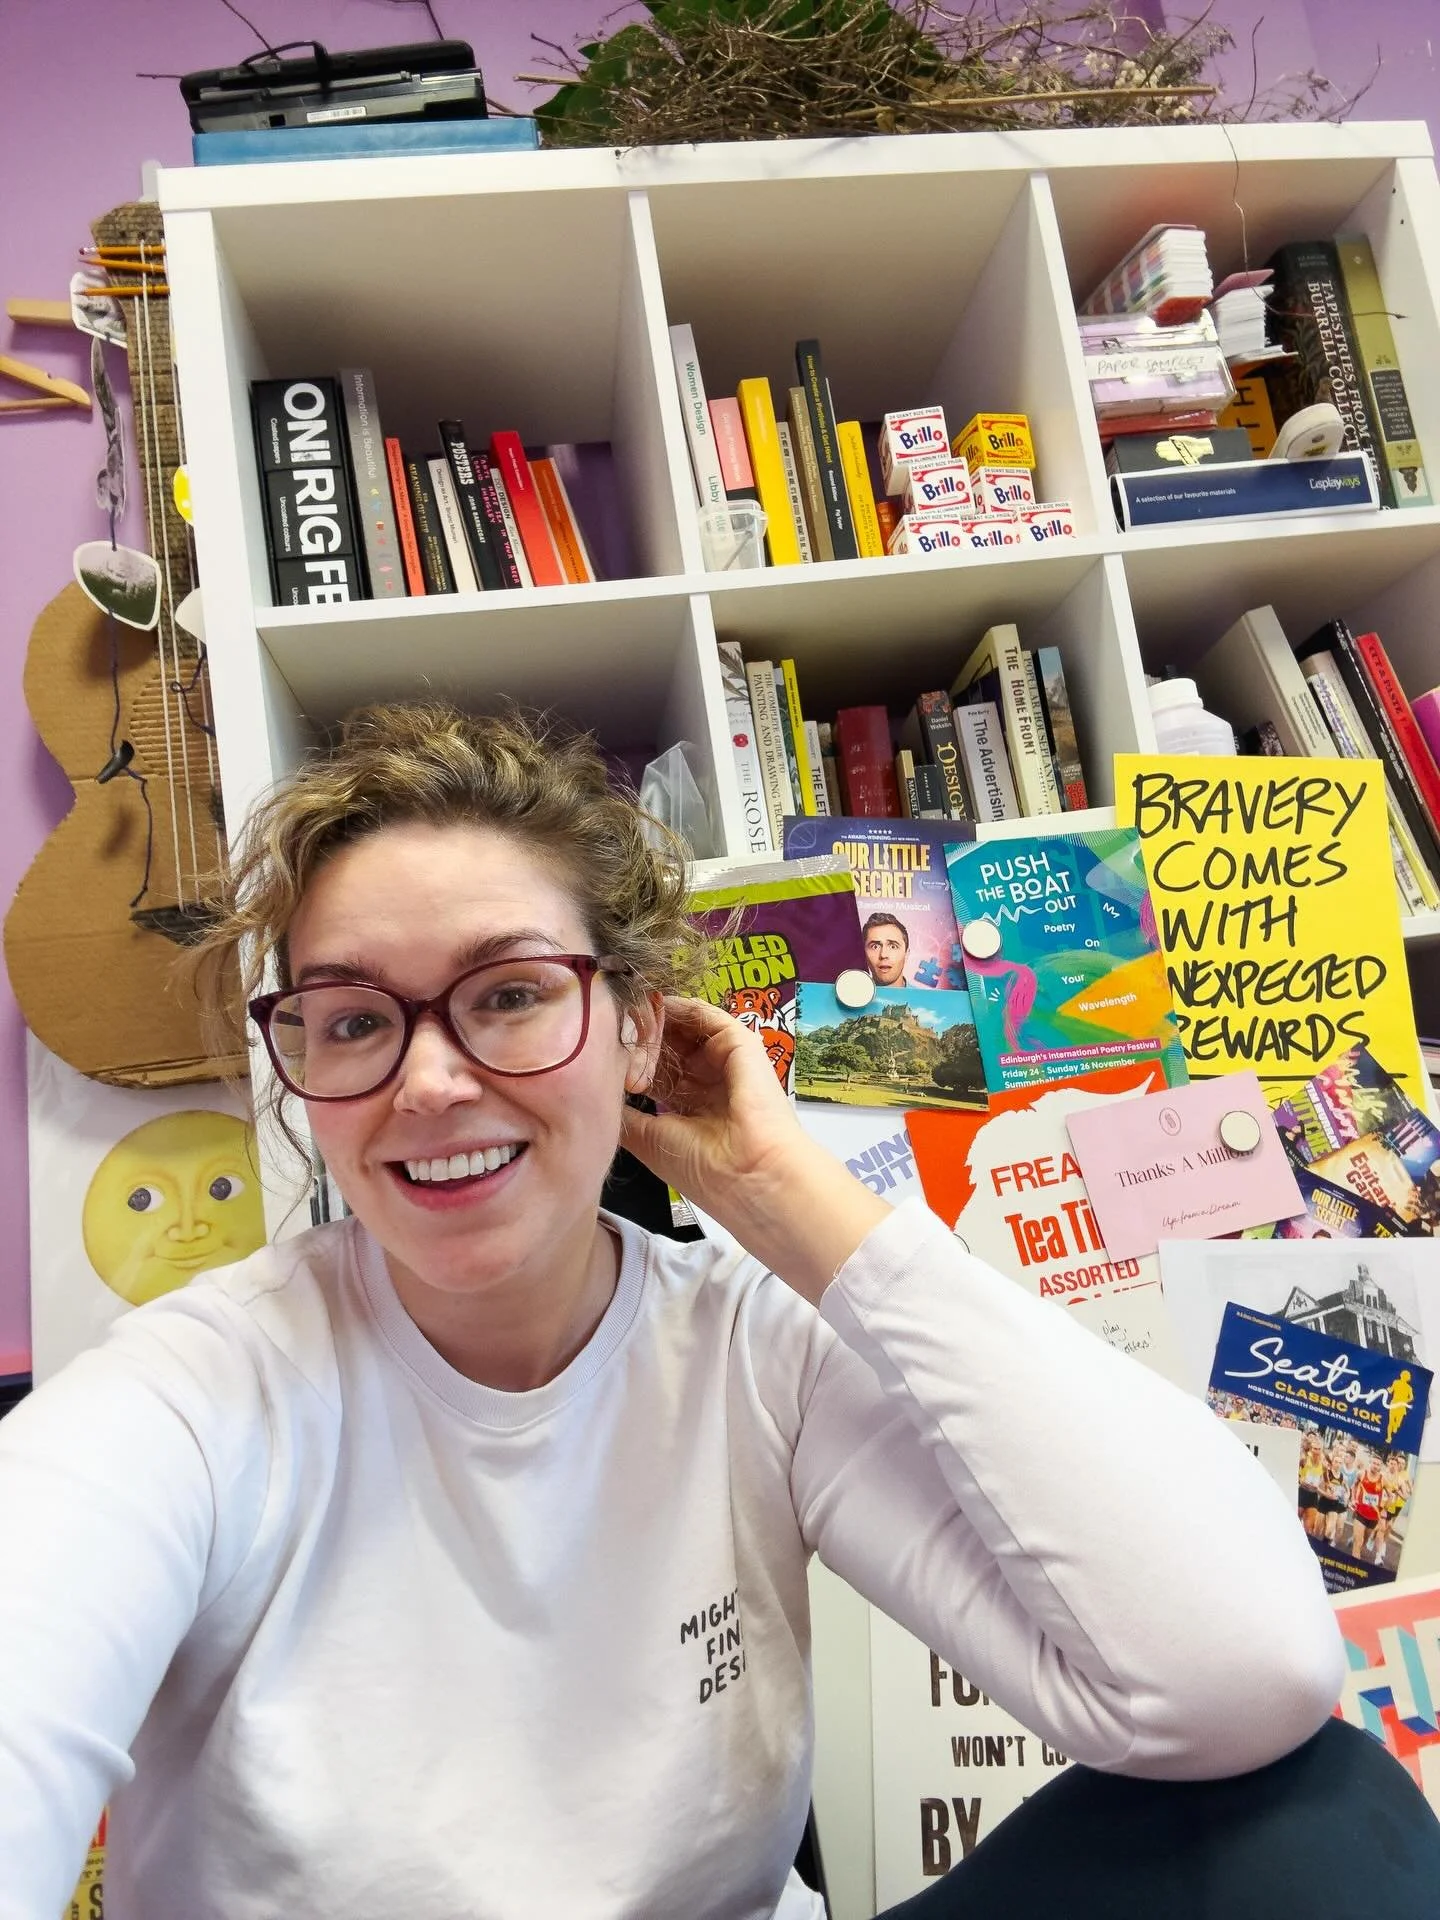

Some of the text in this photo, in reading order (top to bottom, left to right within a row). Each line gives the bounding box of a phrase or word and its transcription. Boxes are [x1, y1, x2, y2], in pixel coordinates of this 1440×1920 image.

[1308, 282, 1336, 357] BURRELL
[806, 355, 814, 369] How
[1322, 282, 1355, 383] TAPESTRIES
[1348, 389, 1370, 439] FROM
[810, 376, 820, 398] Create
[270, 417, 281, 464] Coated papers
[354, 374, 377, 479] Information is Beautiful
[685, 361, 720, 503] Women Design Libby
[821, 434, 830, 445] Get
[899, 425, 943, 450] Brillo
[988, 432, 1024, 450] Brillo
[824, 445, 833, 463] Hired
[409, 463, 425, 515] MEANING OF
[435, 468, 445, 488] Design
[451, 442, 486, 543] POSTERS JOHN BARNICOAT
[473, 460, 496, 523] DAVID SHRIGLEY
[922, 477, 966, 501] Brillo
[994, 485, 1031, 504] Brillo
[498, 491, 511, 519] DESIGN
[1141, 495, 1166, 503] selection
[1184, 491, 1208, 499] favourite
[1209, 488, 1236, 496] materials
[279, 496, 292, 552] Uncoated colours
[488, 485, 520, 584] HAVE SEX IN YOUR BEER
[971, 530, 1013, 548] Brillo
[1029, 520, 1072, 542] Brillo
[918, 531, 961, 552] Brillo
[1004, 646, 1036, 755] THE HOME FRONT
[753, 674, 780, 799] PAINTING AND DRAWING
[764, 672, 786, 774] THE COMPLETE GUIDE TO
[973, 718, 989, 745] The
[1023, 658, 1058, 791] POPULAR HOUSEPLANTS
[811, 766, 823, 790] THE
[740, 761, 767, 853] THE ROSE
[906, 778, 920, 812] MANUEL
[1132, 773, 1368, 838] BRAVERY
[832, 841, 931, 871] OUR LITTLE
[980, 852, 1050, 885] PUSH
[1153, 840, 1348, 892] COMES
[852, 871, 914, 899] SECRET
[976, 871, 1071, 903] THE BOAT
[895, 902, 930, 911] Musical
[1045, 895, 1077, 914] OUT
[1044, 923, 1076, 934] Poetry
[1162, 895, 1298, 952] WITH
[1084, 938, 1100, 948] On
[702, 953, 796, 1005] NION
[1061, 973, 1085, 985] Your
[1078, 992, 1138, 1012] Wavelength
[1174, 1010, 1370, 1062] REWARDS
[1000, 1054, 1048, 1065] Edinburgh's
[1101, 1044, 1125, 1054] Poetry
[1127, 1041, 1157, 1050] Festival
[1002, 1069, 1027, 1079] Friday
[1029, 1068, 1039, 1076] 24
[1047, 1064, 1079, 1075] Sunday
[1091, 1058, 1136, 1069] November
[845, 1128, 912, 1180] NIN
[1114, 1156, 1194, 1188] Thanks A
[1312, 1188, 1334, 1210] OUR
[1005, 1199, 1106, 1267] Tea Ti
[1039, 1257, 1141, 1298] ASSORTED
[1224, 1336, 1412, 1410] Seaton
[1247, 1384, 1275, 1397] HOSTED
[1284, 1395, 1309, 1409] NORTH
[1309, 1404, 1330, 1415] DOWN
[1330, 1412, 1362, 1427] ATHLETIC
[1362, 1422, 1381, 1433] CLUB
[1274, 1380, 1382, 1424] CLASSIC 10K
[680, 1587, 738, 1644] MIGH
[706, 1618, 740, 1665] FIN
[929, 1649, 992, 1708] FO
[951, 1735, 1026, 1768] WON'T
[920, 1797, 982, 1876] BY
